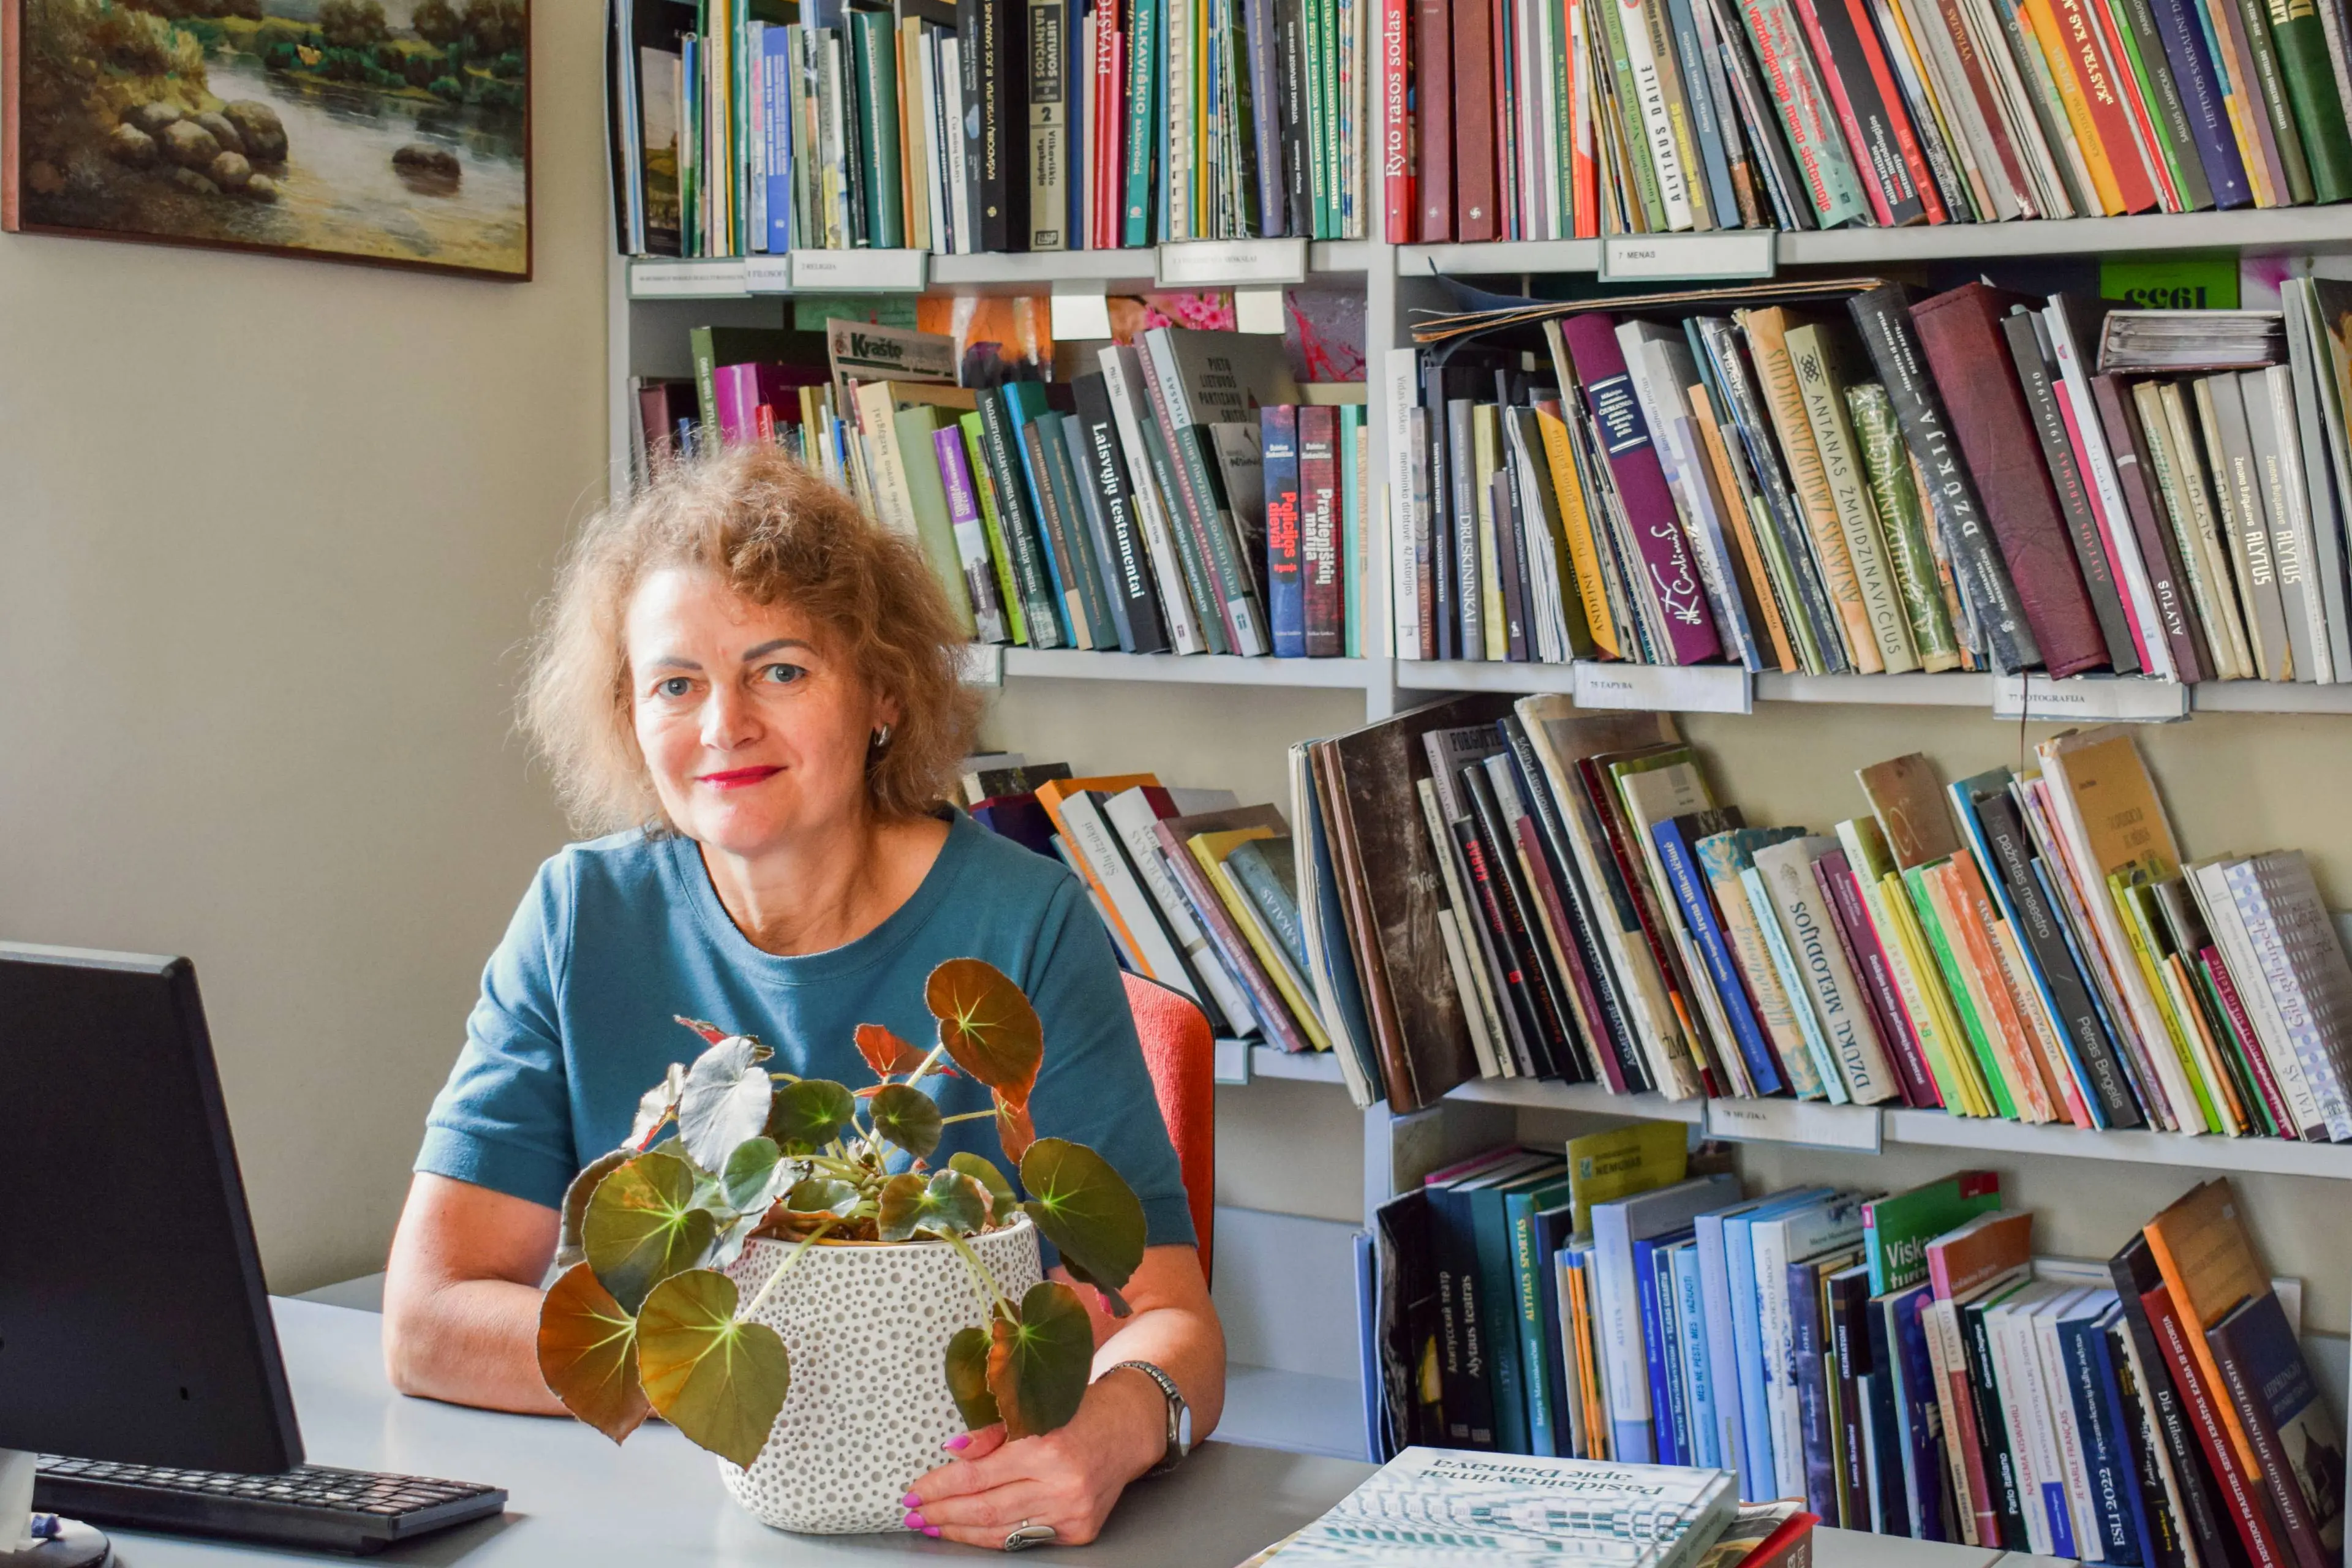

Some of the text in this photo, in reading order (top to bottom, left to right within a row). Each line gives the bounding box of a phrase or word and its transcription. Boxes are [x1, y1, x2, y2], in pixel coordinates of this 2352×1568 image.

[1034, 9, 1047, 78] BAŽNYČIOS
[1047, 20, 1058, 76] LIETUVOS
[1945, 6, 1973, 61] VYTAUTAS
[2066, 12, 2089, 43] KAS
[1135, 10, 1150, 114] VILKAVIŠKIO
[2077, 42, 2101, 74] YRA
[1384, 10, 1406, 177] Ryto rasos sodas
[1621, 82, 1642, 140] Nemunas
[1744, 5, 1795, 105] vaizduojamojo
[1784, 104, 1807, 144] meno
[1796, 145, 1835, 214] sistemoje
[2155, 66, 2190, 143] SAULIUS LAMPICKAS
[2190, 74, 2219, 129] LIETUVOS
[2273, 103, 2287, 129] LIETUVOS
[1047, 130, 1056, 185] Vilkaviškio
[1638, 63, 1681, 202] ALYTAUS DAILĖ
[1868, 113, 1896, 176] metodologijos
[1870, 143, 1898, 206] dailės kritikos
[1891, 152, 1913, 200] metmenys
[1164, 375, 1186, 425] ATLASAS
[1395, 375, 1406, 401] Vidas
[1155, 459, 1169, 486] METAIS
[1181, 430, 1198, 462] SRITIS
[1912, 406, 1985, 540] DZŪKIJA
[1000, 468, 1016, 500] VISADA
[1191, 462, 1215, 518] PARTIZANŲ
[1398, 451, 1410, 499] menininko
[1008, 499, 1017, 510] IR
[1011, 510, 1023, 536] VISUR
[1088, 421, 1122, 496] Laisvųjų
[1109, 496, 1145, 600] testamentai
[1268, 502, 1281, 549] dievai
[1281, 492, 1298, 558] Policijos
[1566, 505, 1589, 557] Dainavos
[1808, 391, 1907, 656] ANTANAS ŽMUIDZINAVIČIUS
[2056, 450, 2106, 583] ALYTAUS ALBUMAS
[2210, 469, 2241, 538] ALYTUS
[2233, 456, 2273, 586] Zenono Bulgakovo ALYTUS
[2265, 454, 2303, 585] Zenono Bulgakovo ALYTUS
[1017, 536, 1031, 564] KURIE
[1207, 518, 1229, 565] LIETUVOS
[1303, 512, 1316, 561] mafija
[1316, 489, 1334, 585] Pravieniškių
[1403, 545, 1412, 556] 42
[1814, 519, 1863, 608] ANTANAS
[1222, 567, 1238, 596] PIETŲ
[1402, 557, 1415, 596] istorijos
[1454, 513, 1479, 623] DRUSKININKAI
[2154, 579, 2187, 638] ALYTUS
[1463, 839, 1491, 883] KARAS
[1259, 886, 1301, 948] SAKALAS
[1688, 902, 1708, 932] Irena
[2018, 884, 2053, 940] maestro
[1789, 899, 1847, 1016] MELODIJOS
[2268, 963, 2300, 998] gili
[2279, 995, 2308, 1030] Gili
[1831, 1019, 1873, 1090] DZŪKŲ
[2075, 1014, 2125, 1110] Petras Bingelis
[1437, 1270, 1455, 1303] театр
[1514, 1216, 1536, 1322] ALYTAUS SPORTAS
[1458, 1274, 1484, 1379] Alytaus teatras
[1687, 1321, 1699, 1340] MES
[2159, 1314, 2185, 1354] ISTORIJA
[1694, 1367, 1704, 1382] NE
[2177, 1352, 2188, 1365] IR
[2181, 1364, 2202, 1396] KALBA
[1695, 1383, 1706, 1403] MES
[2155, 1389, 2174, 1412] Dla
[1433, 1458, 1634, 1482] apie Dainavą
[2055, 1408, 2085, 1502] JE PARLE FRANÇAIS
[2222, 1358, 2302, 1531] LEIPALINGIO APYLINKIŲ TEKSTAI
[1419, 1469, 1665, 1496] Pasidainavimai
[1994, 1451, 2021, 1515] Parlo italiano
[2018, 1453, 2038, 1496] NASEMA
[2096, 1466, 2126, 1547] ESLI 2022
[2245, 1518, 2272, 1562] DZŪKIJOS
